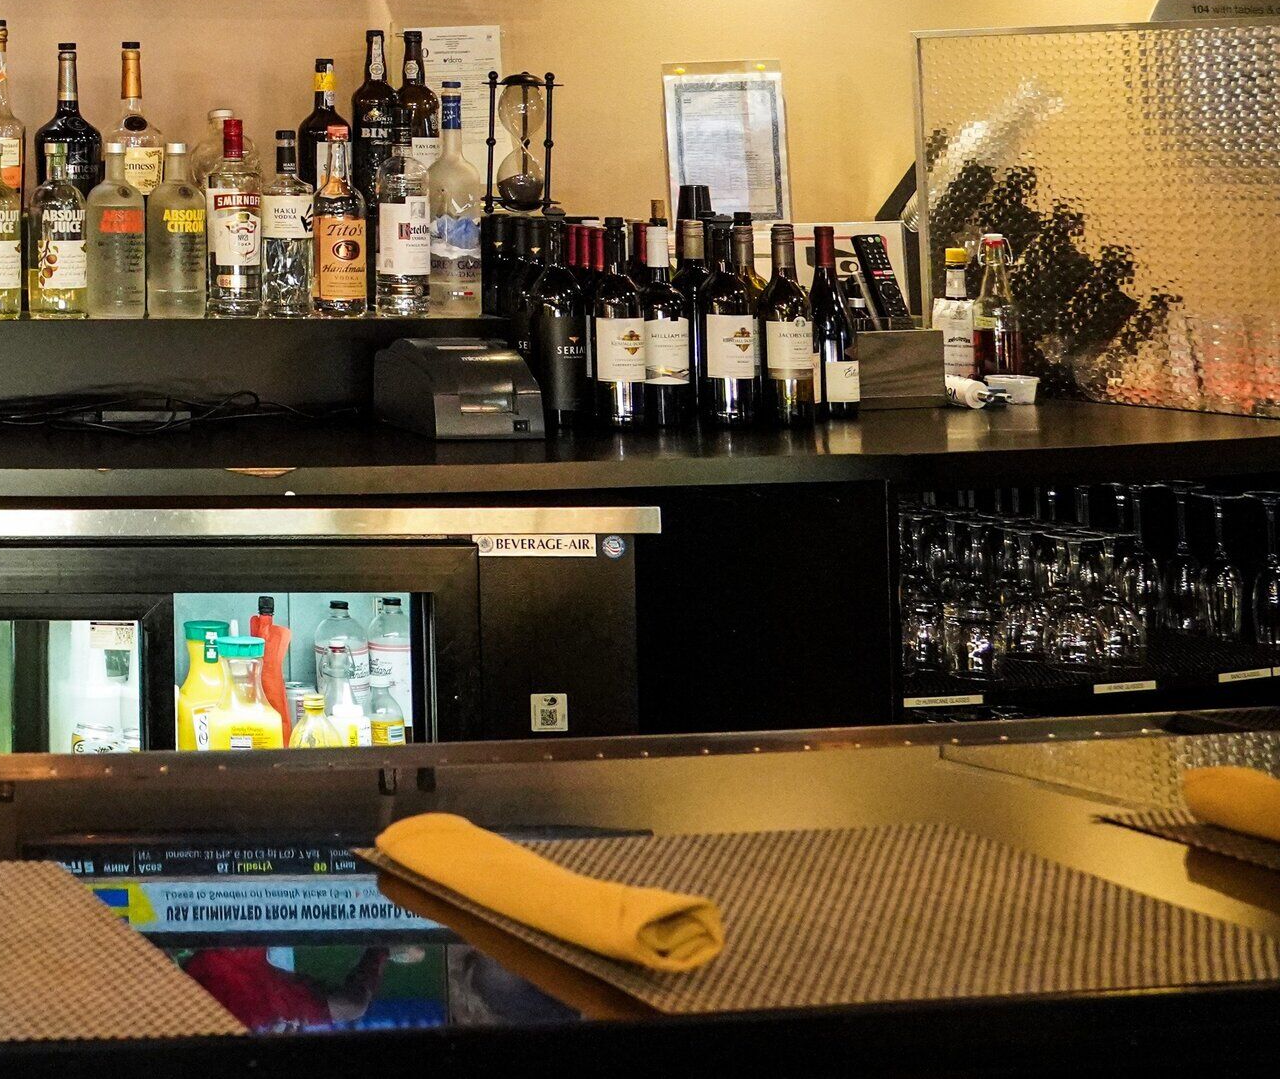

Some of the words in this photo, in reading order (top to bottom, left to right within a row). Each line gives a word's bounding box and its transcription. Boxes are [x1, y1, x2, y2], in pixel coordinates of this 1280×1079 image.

[1192, 5, 1209, 14] 104
[124, 161, 157, 172] ennessy
[42, 209, 86, 222] ABSOLUT
[164, 209, 206, 221] ABSOLUT
[52, 221, 82, 233] JUICE
[167, 220, 205, 233] CITRON
[327, 223, 363, 238] Tito's
[495, 538, 590, 550] BEVERAGE-AIR
